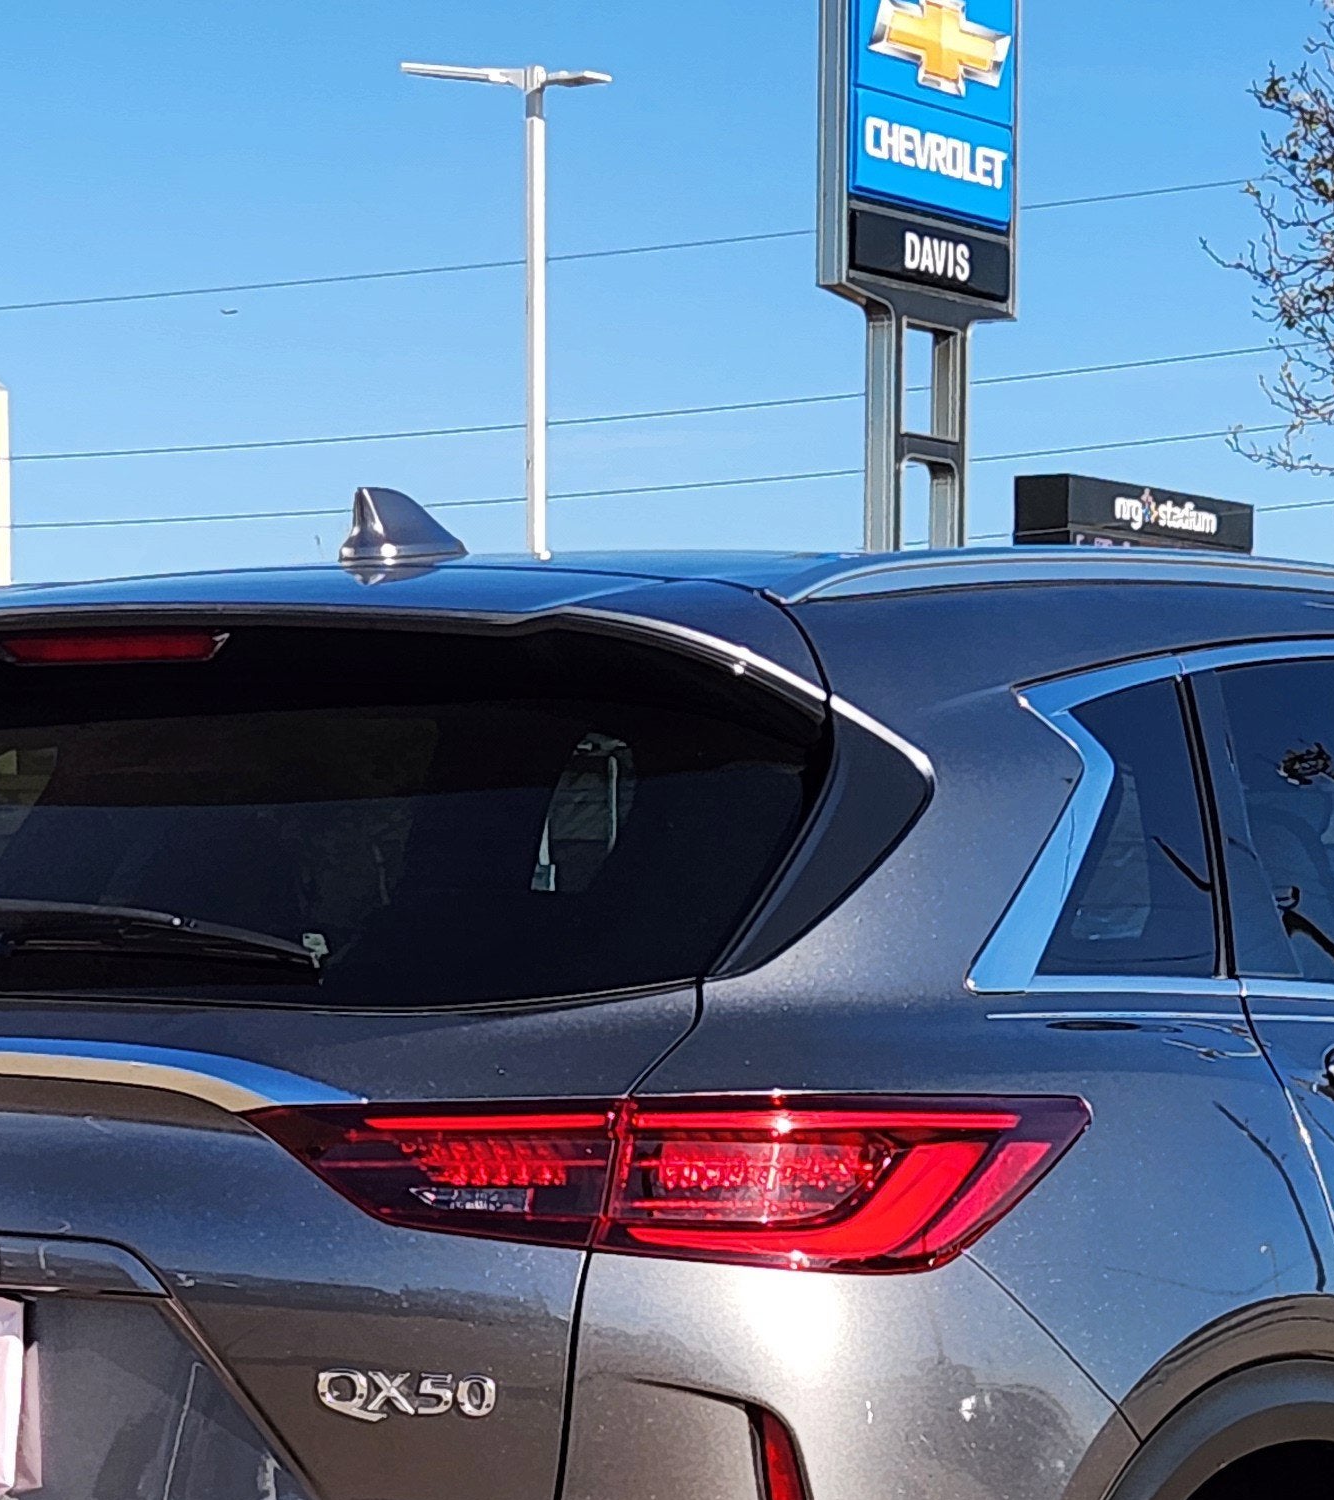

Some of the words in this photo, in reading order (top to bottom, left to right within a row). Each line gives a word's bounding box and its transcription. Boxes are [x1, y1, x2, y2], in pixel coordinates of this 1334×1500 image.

[865, 115, 1008, 190] CHEVROLET
[904, 230, 970, 282] DAVIS
[1158, 500, 1218, 536] stadium
[317, 1367, 496, 1423] QX50
